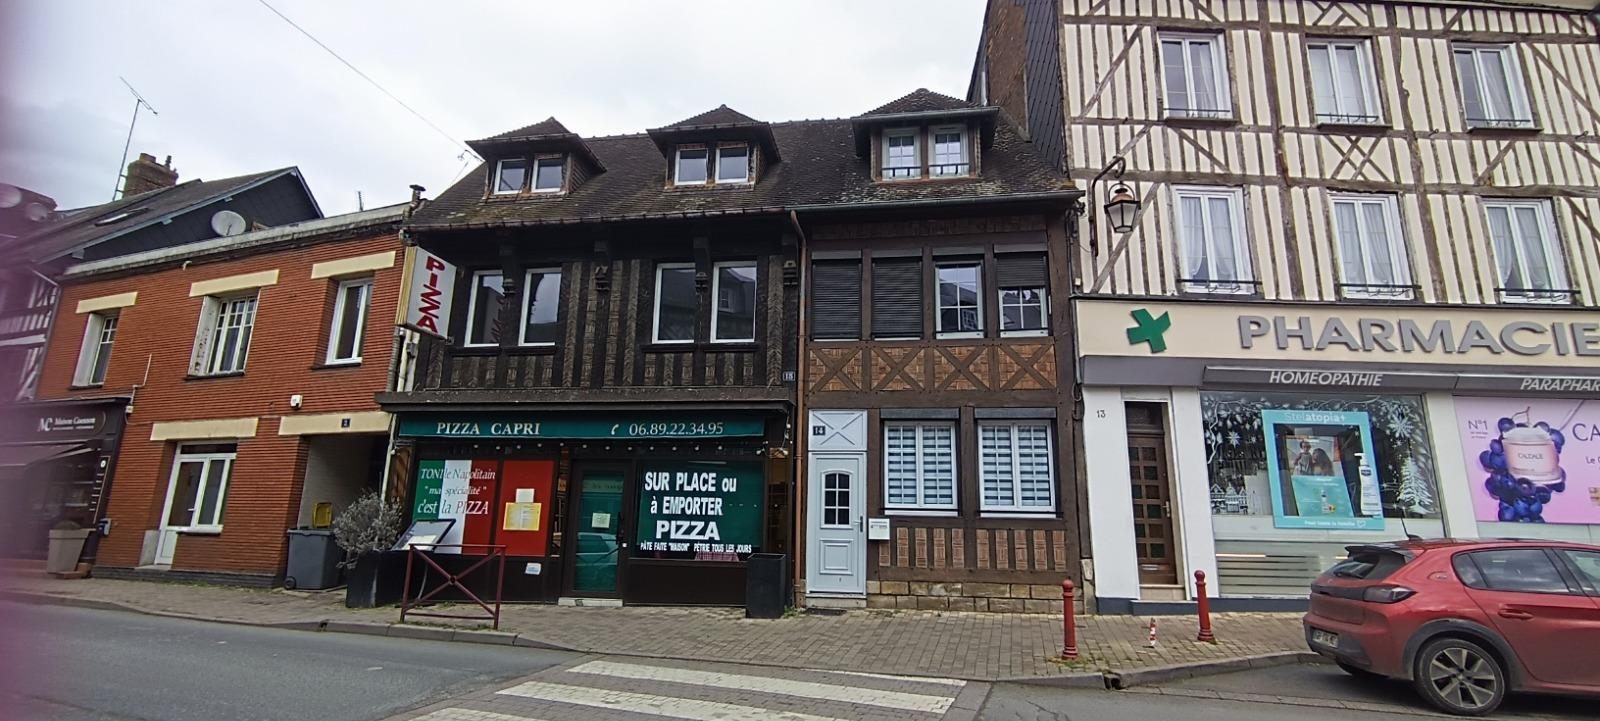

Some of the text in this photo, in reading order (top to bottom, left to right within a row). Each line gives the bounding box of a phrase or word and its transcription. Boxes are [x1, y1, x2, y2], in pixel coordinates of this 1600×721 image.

[416, 256, 446, 334] PIZZA
[1238, 315, 1600, 356] PHARMACIE
[1269, 371, 1383, 386] HOMEOPATHIE
[1096, 409, 1106, 418] 13
[436, 422, 541, 435] PIZZA CAPRI
[629, 422, 724, 436] 06.89.22.34.95
[421, 468, 444, 479] TONI
[453, 468, 496, 481] Napolitain
[644, 472, 670, 491] SUR
[675, 472, 717, 492] PLACE
[417, 499, 489, 515] c'est la PIZZA
[650, 496, 723, 516] à EMPORTER
[656, 520, 720, 541] PIZZA
[654, 542, 668, 551] FAITE
[711, 543, 725, 553] TOUS
[725, 544, 735, 553] LES
[735, 544, 752, 554] JOURS
